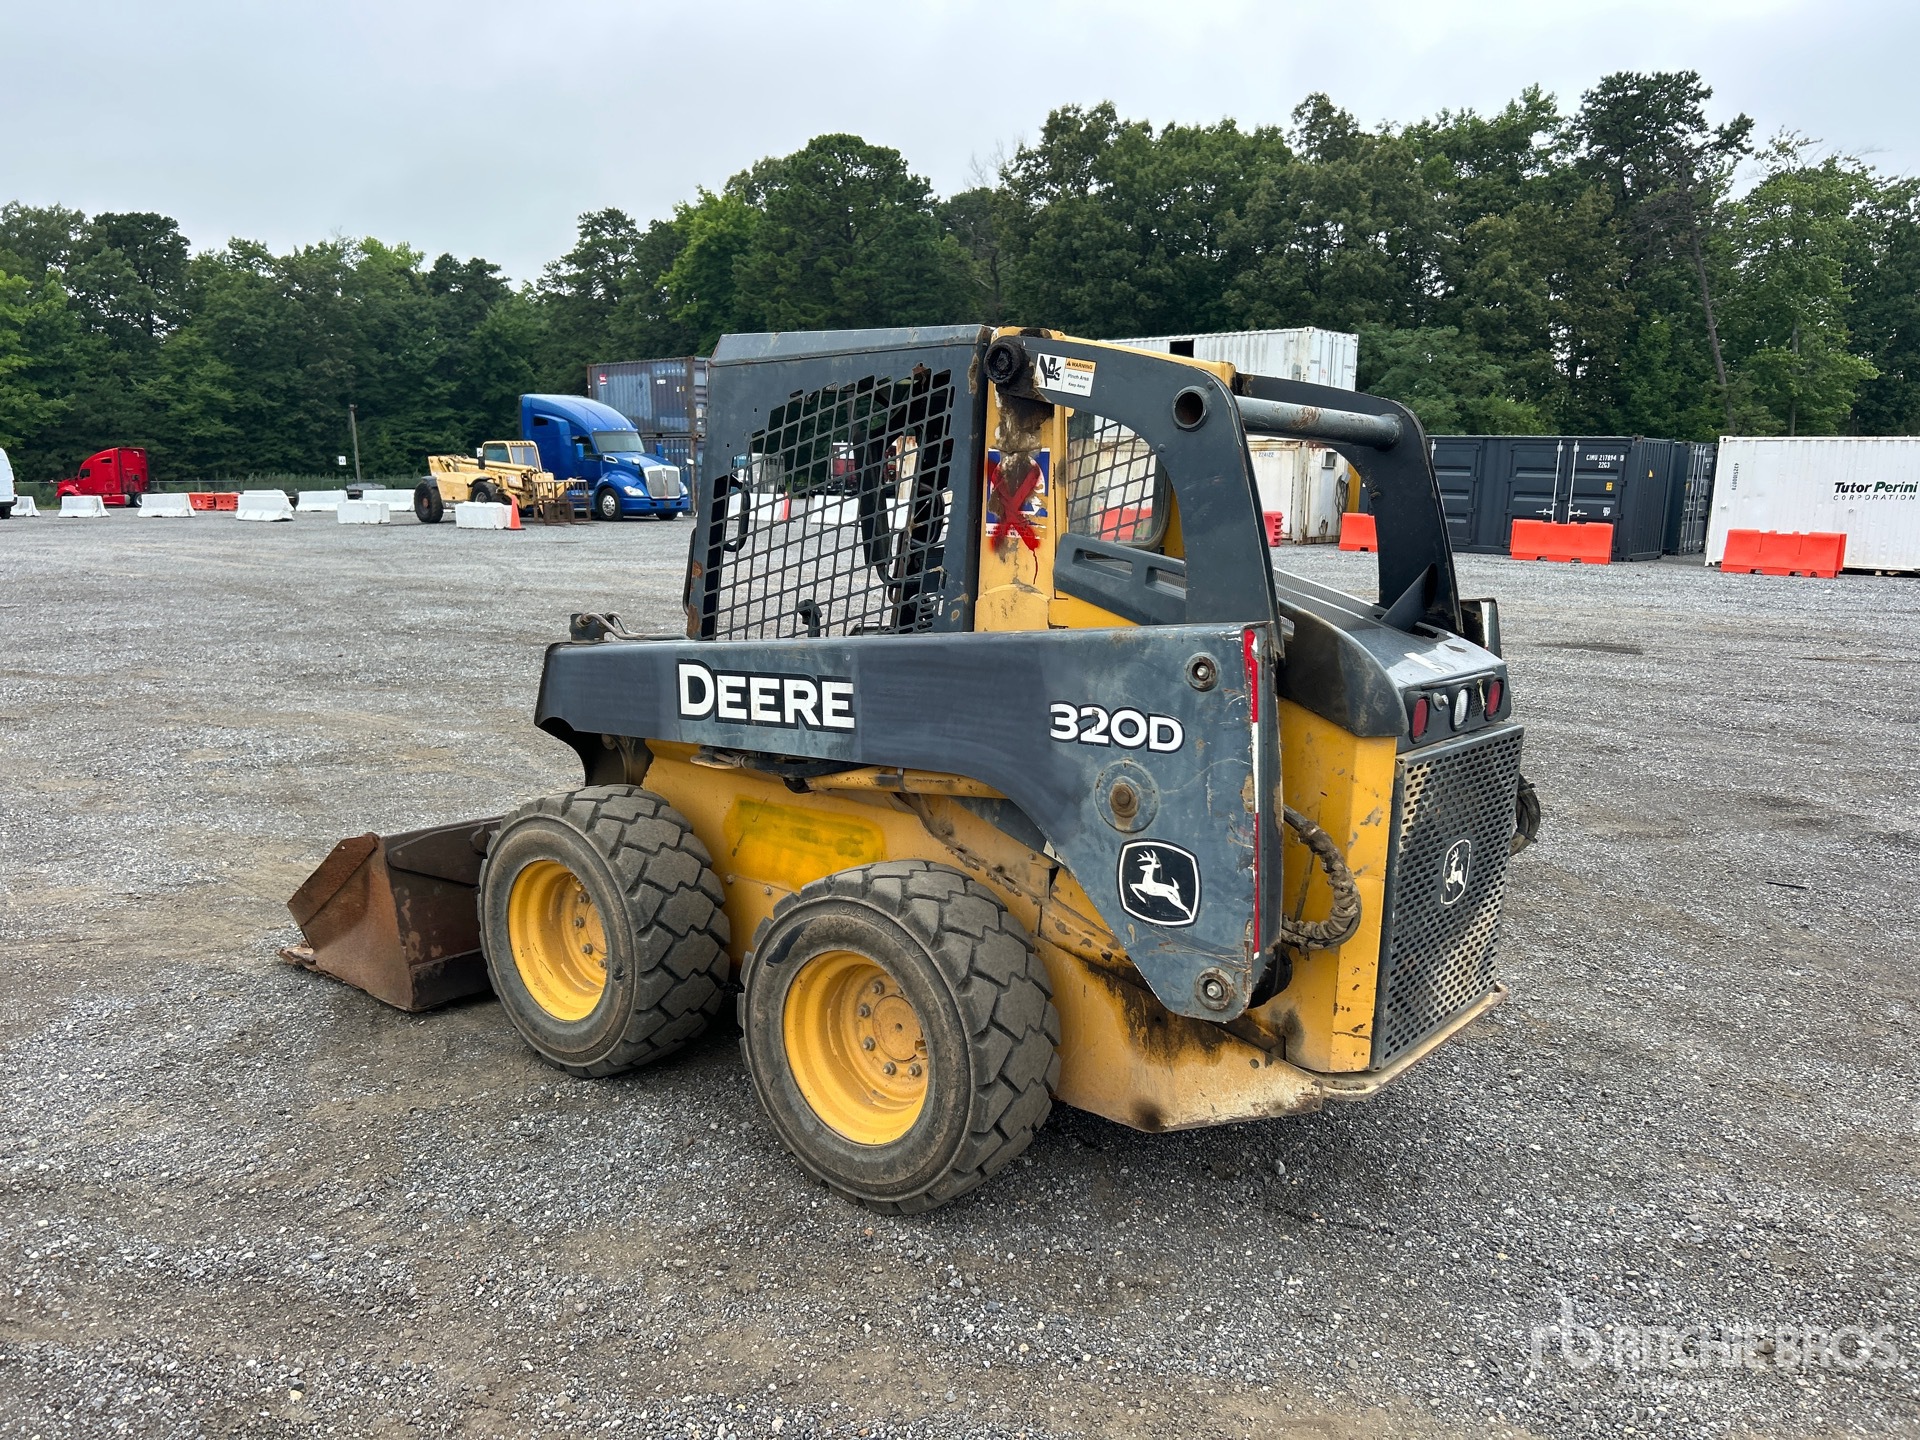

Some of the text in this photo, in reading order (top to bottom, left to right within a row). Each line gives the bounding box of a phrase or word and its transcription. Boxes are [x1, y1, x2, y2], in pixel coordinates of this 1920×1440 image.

[1834, 481, 1918, 493] Tutor Perini
[678, 663, 855, 729] DEERE
[1049, 703, 1184, 753] 320D
